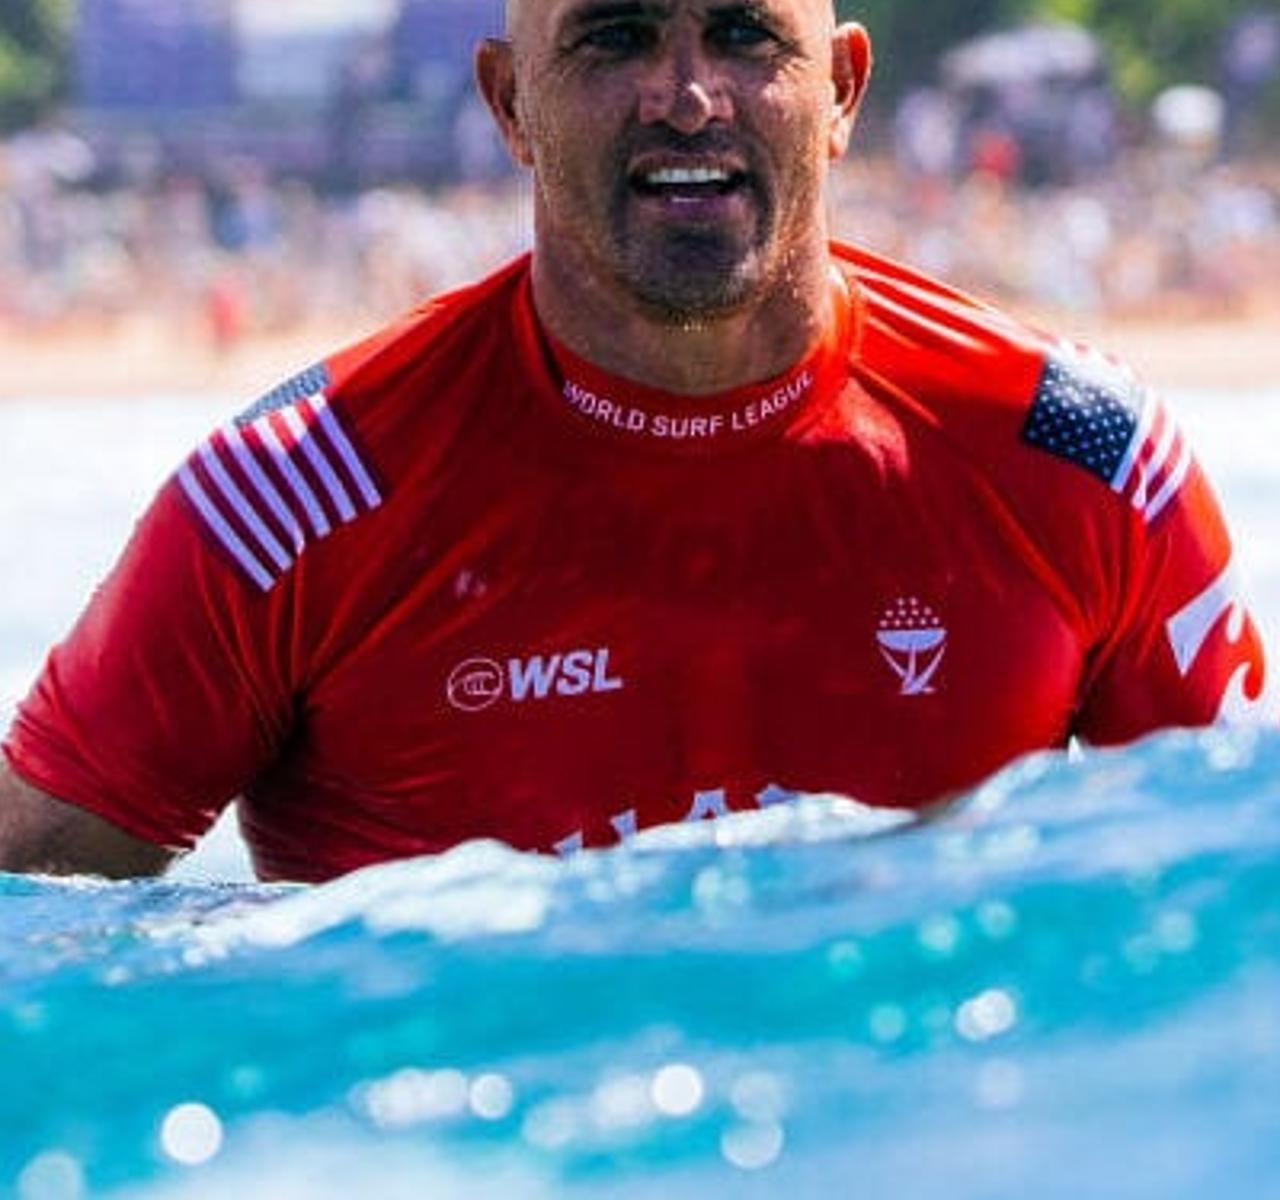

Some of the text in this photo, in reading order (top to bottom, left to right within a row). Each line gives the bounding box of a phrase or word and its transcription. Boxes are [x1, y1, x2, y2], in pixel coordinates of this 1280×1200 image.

[562, 379, 647, 432] WORLD
[651, 414, 725, 439] SURF
[507, 647, 623, 701] WSL
